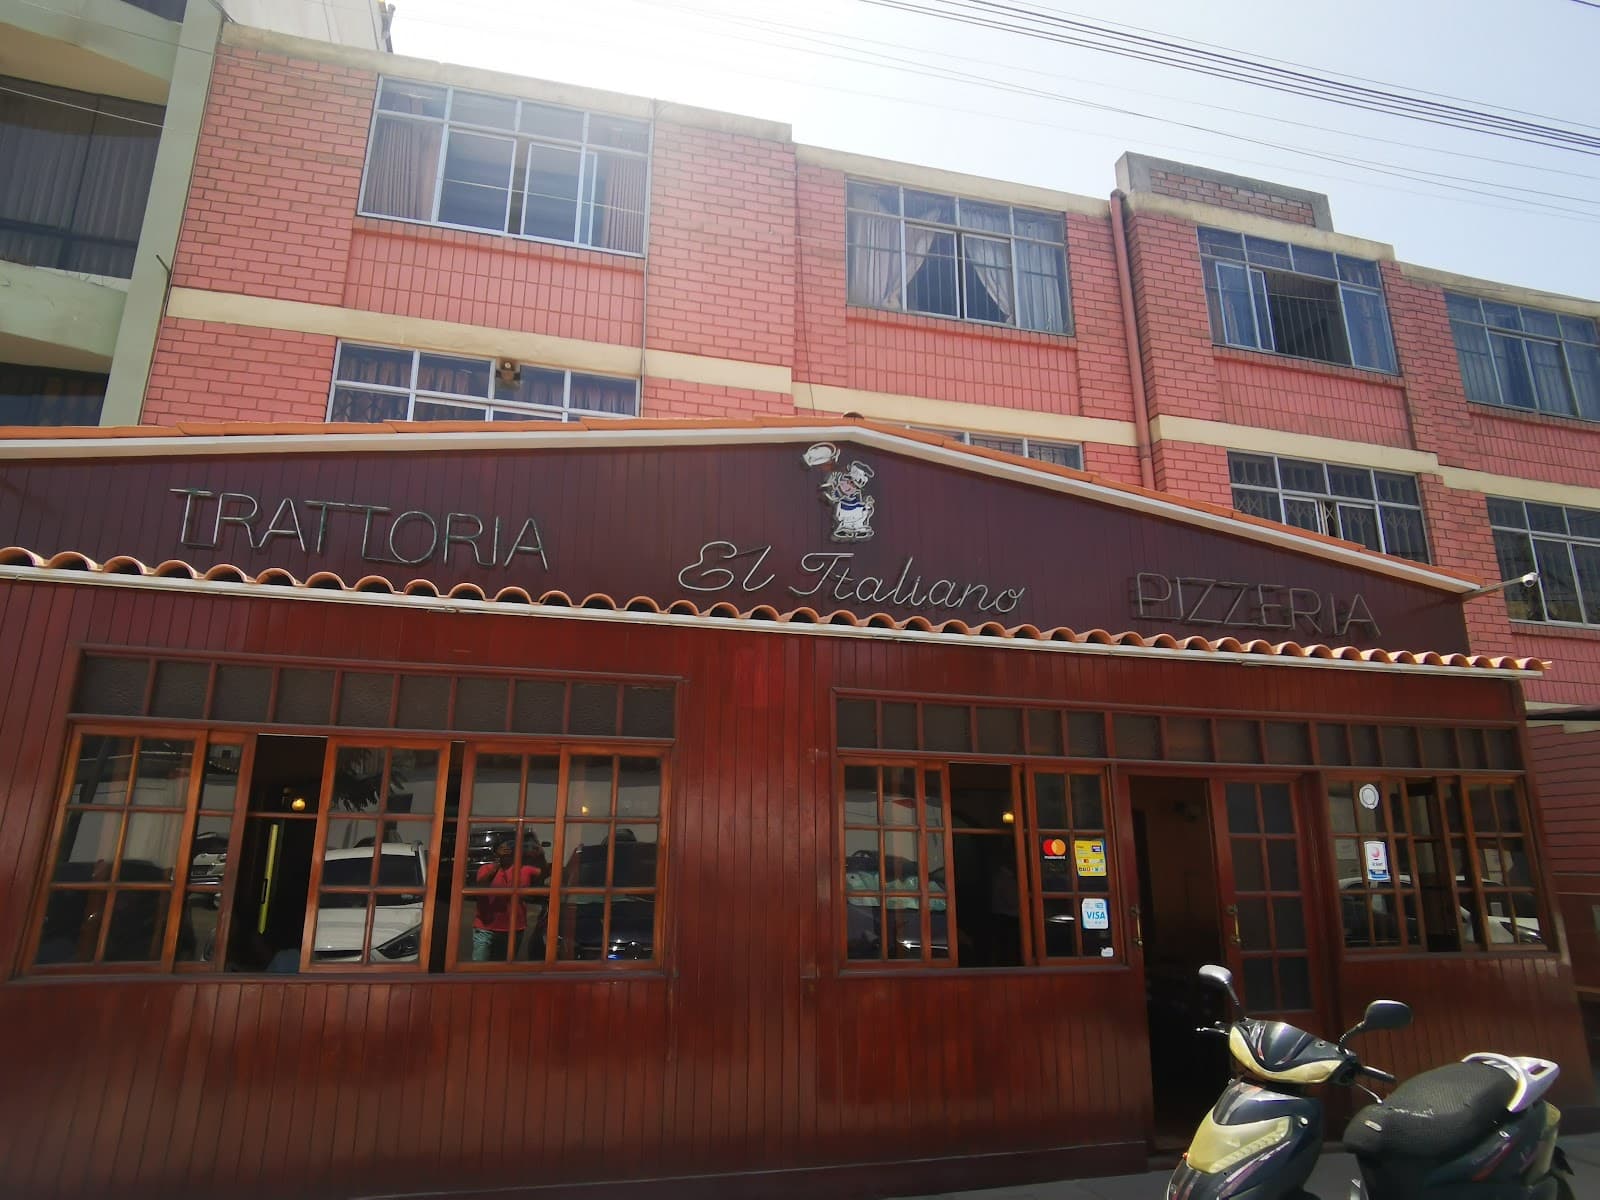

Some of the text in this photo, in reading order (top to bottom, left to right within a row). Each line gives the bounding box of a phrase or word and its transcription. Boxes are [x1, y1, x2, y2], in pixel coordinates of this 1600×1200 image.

[169, 487, 549, 571] TRATTORIA
[678, 541, 1025, 614] El Italiano
[1136, 572, 1382, 637] PIZZERIA
[1086, 911, 1106, 920] VISA
